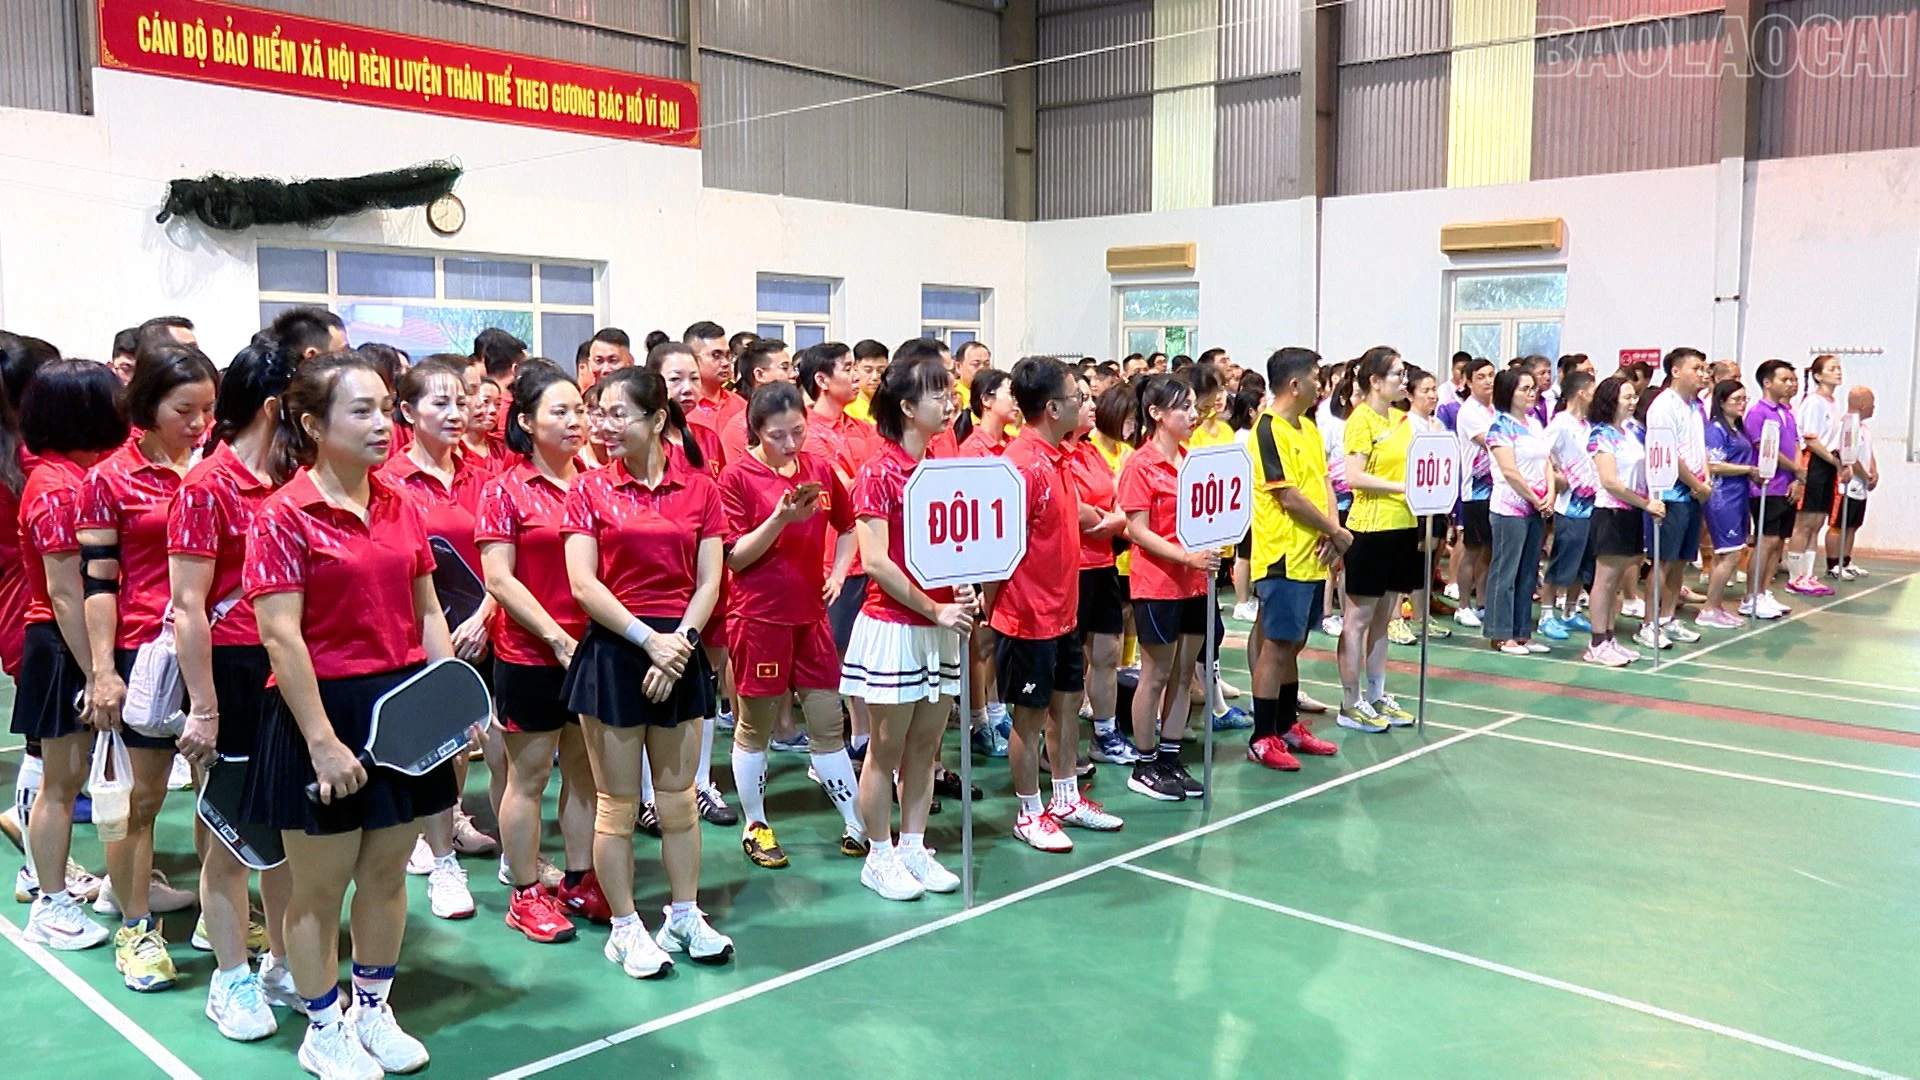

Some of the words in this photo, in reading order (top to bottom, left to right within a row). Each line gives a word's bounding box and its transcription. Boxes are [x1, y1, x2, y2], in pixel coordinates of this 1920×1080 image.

[138, 11, 178, 56] CÁN
[182, 18, 208, 68] BỘ
[212, 16, 249, 67] BẢO
[253, 25, 297, 74] HIỂM
[301, 39, 324, 78] XÃ
[328, 43, 355, 89] HỘI
[359, 48, 391, 89] RÈN
[395, 56, 442, 101] LUYỆN
[445, 64, 483, 102] THÂN
[486, 64, 512, 106] THỂ
[515, 77, 549, 112] THEO
[552, 82, 595, 118] GƯƠNG
[598, 86, 623, 122] BÁC
[645, 93, 657, 126] VĨ
[660, 99, 680, 134] ĐẠI
[1190, 473, 1225, 524] ĐỘI
[1230, 476, 1242, 512] 2
[1416, 451, 1440, 494] ĐỘI
[1444, 457, 1452, 486] 3
[928, 490, 980, 553] ĐỘI
[991, 497, 1004, 540] 1
